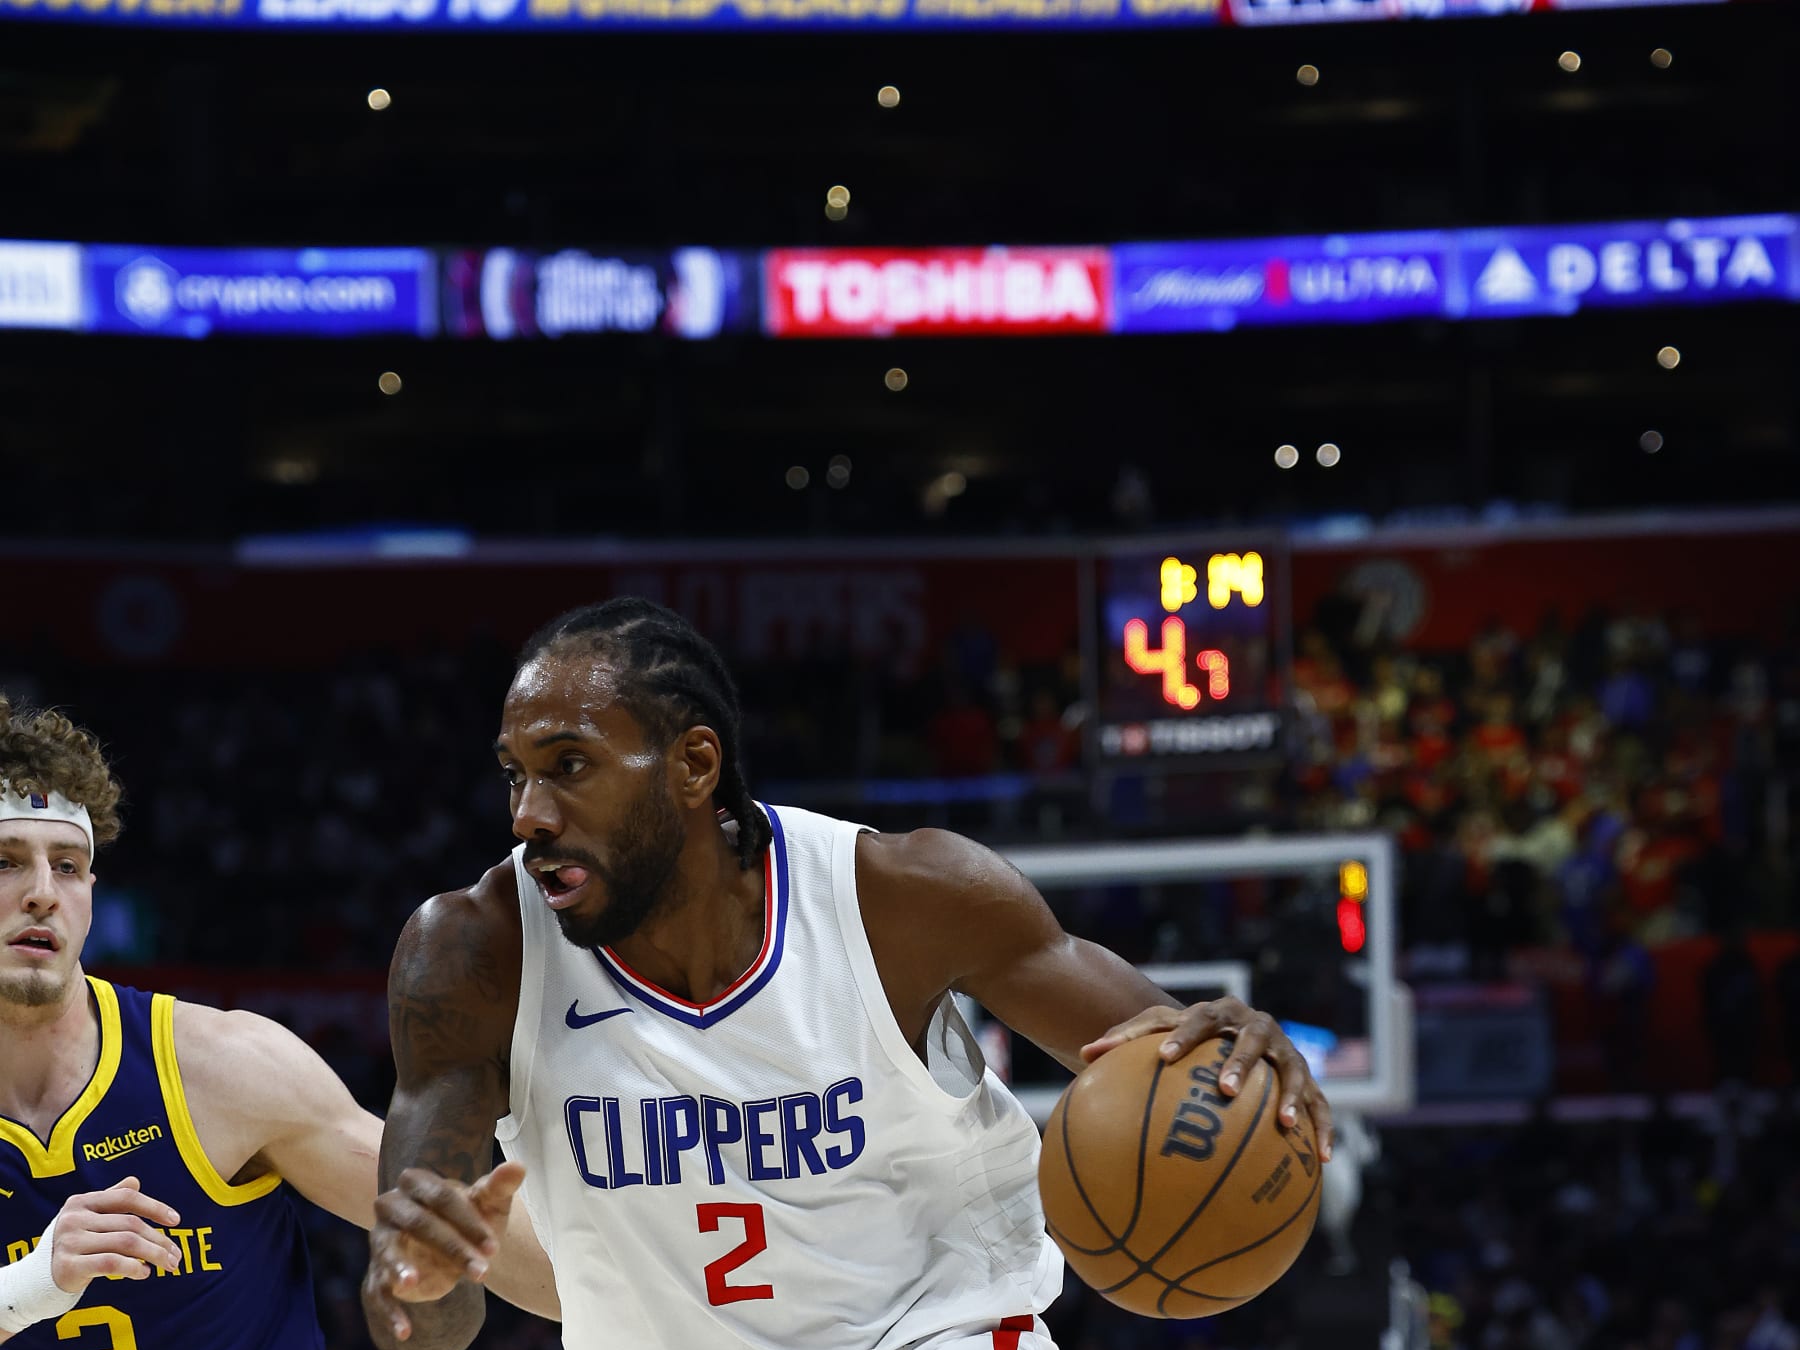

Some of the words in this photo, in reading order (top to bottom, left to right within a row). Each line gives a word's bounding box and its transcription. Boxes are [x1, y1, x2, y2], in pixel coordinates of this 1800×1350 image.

[177, 274, 396, 316] crypto.com
[780, 258, 1098, 324] TOSHIBA
[1547, 238, 1776, 295] DELTA
[82, 1124, 163, 1162] Rakuten
[563, 1076, 866, 1190] CLIPPERS
[696, 1202, 774, 1307] 2
